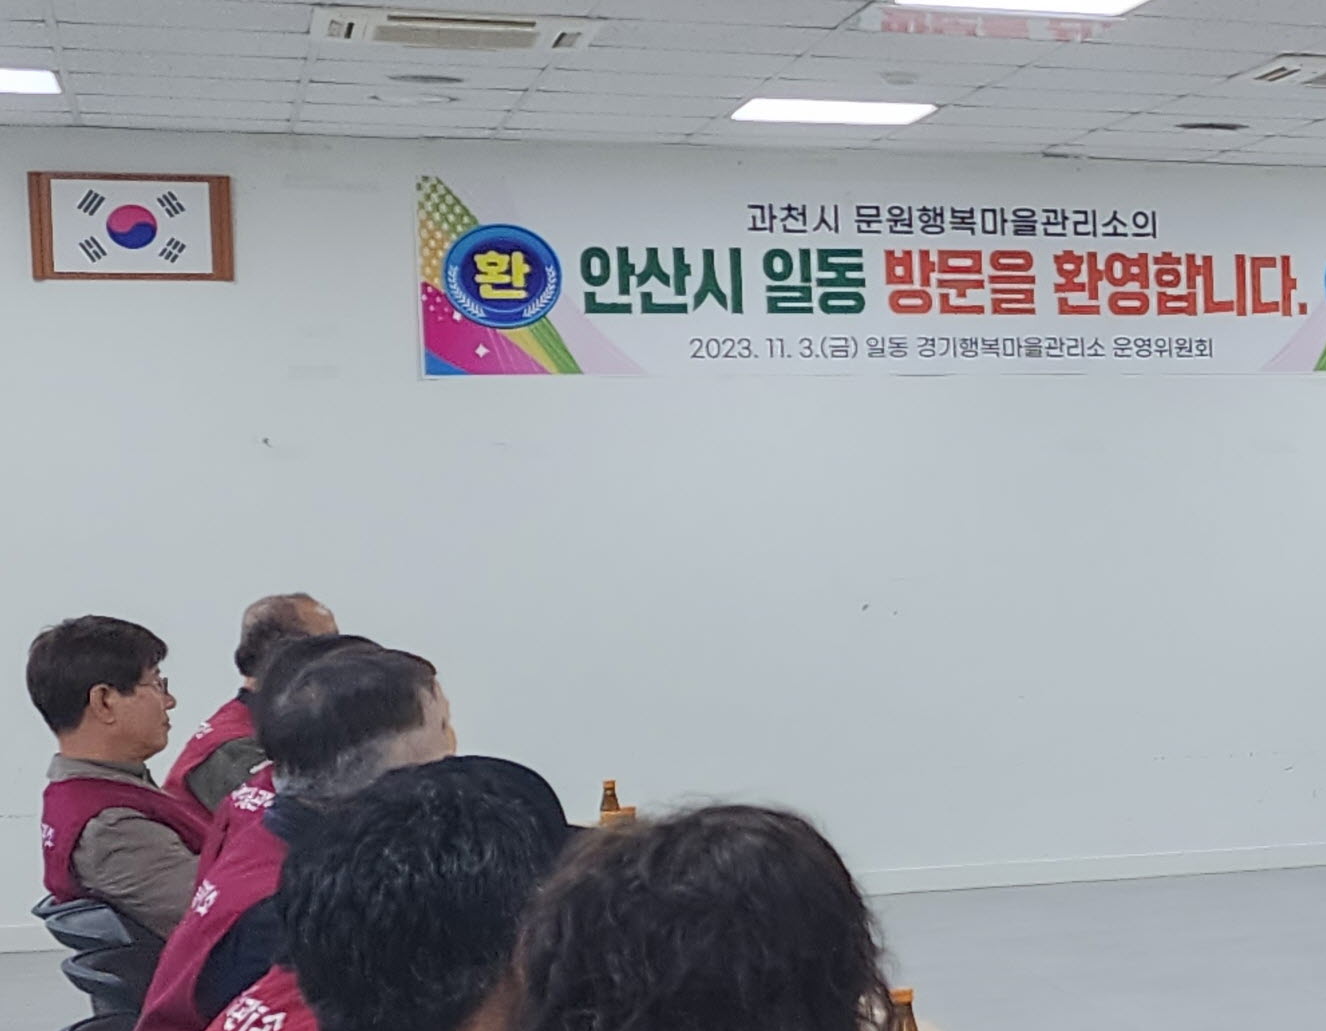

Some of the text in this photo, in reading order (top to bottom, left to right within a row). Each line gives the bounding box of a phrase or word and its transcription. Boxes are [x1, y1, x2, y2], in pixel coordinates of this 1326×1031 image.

[746, 203, 1158, 239] 과천시 문원행복마을관리소의
[473, 250, 530, 300] 환
[580, 246, 1308, 317] 안산시 일동 방문을 환영합니다.
[689, 335, 1214, 359] 2023. 11. 3.(금) 일동 경기행복마을관리소 운영위원회
